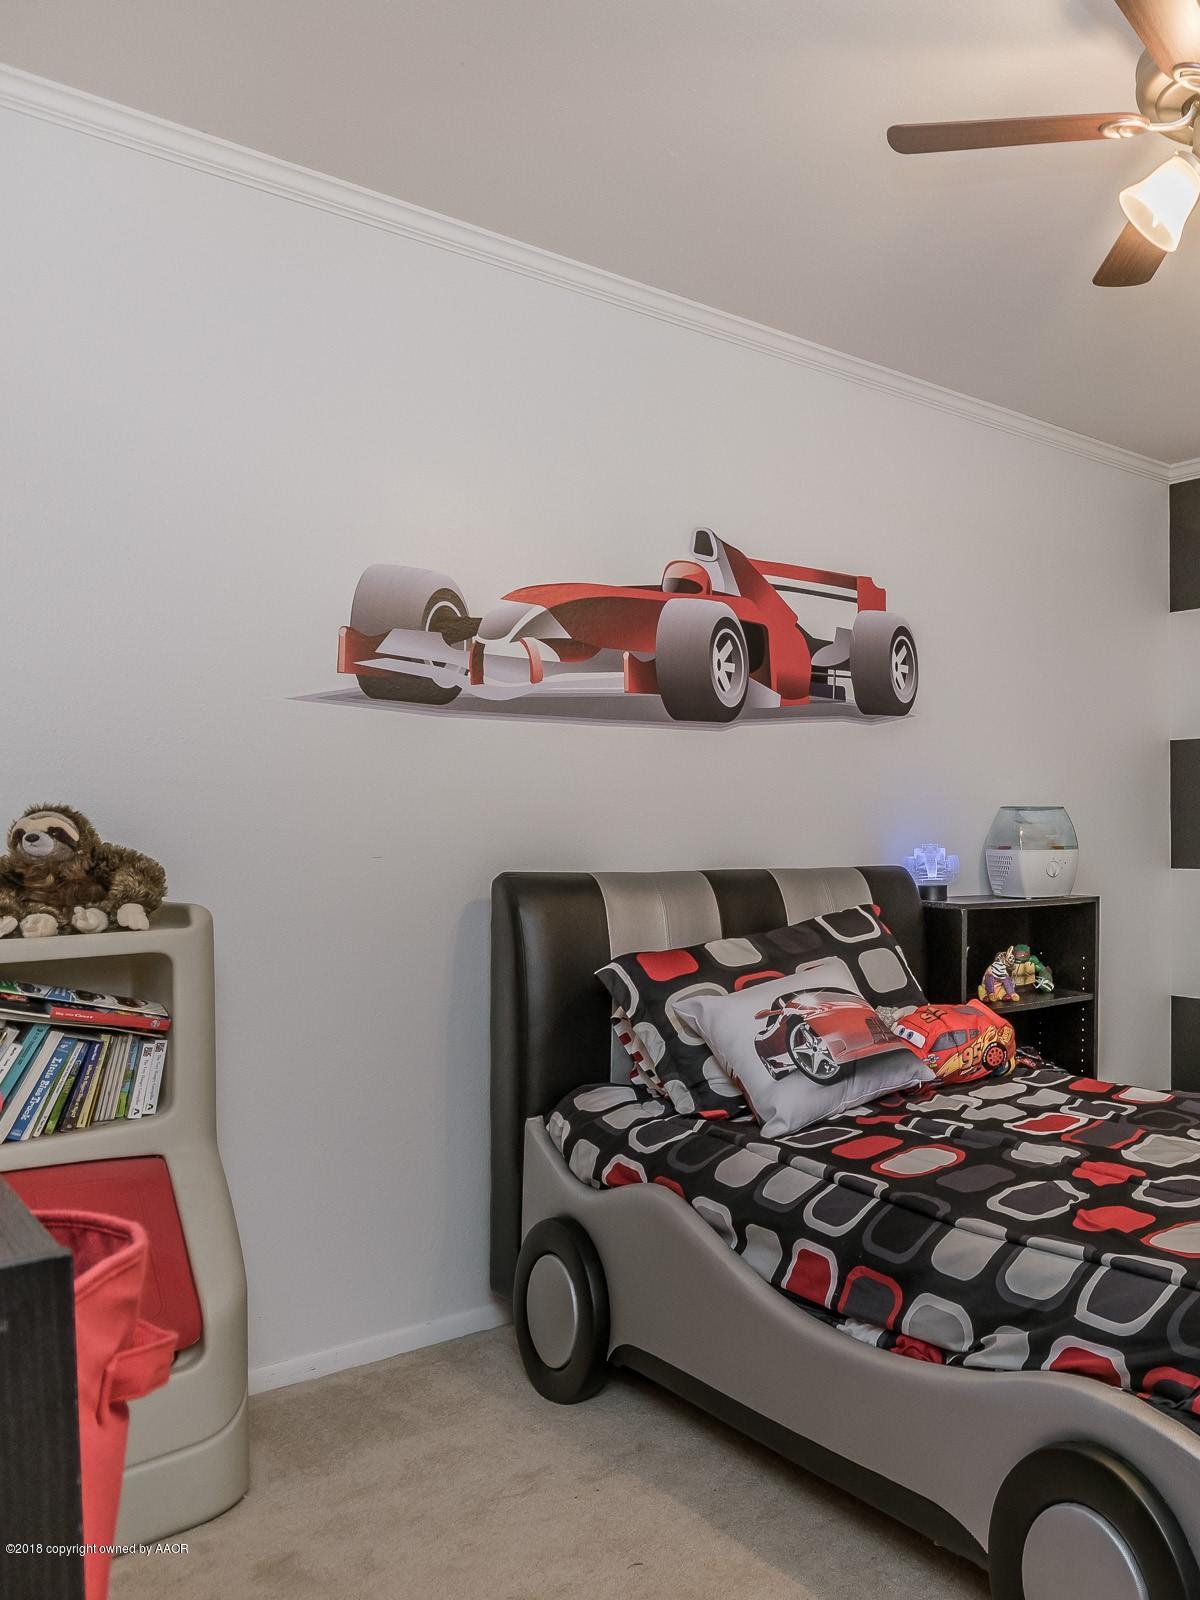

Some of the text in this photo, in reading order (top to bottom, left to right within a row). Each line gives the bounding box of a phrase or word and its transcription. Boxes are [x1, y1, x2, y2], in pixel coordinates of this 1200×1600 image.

[45, 1056, 62, 1079] Little
[961, 1043, 982, 1069] 95
[35, 1079, 51, 1097] Blue
[20, 1096, 41, 1121] Truck
